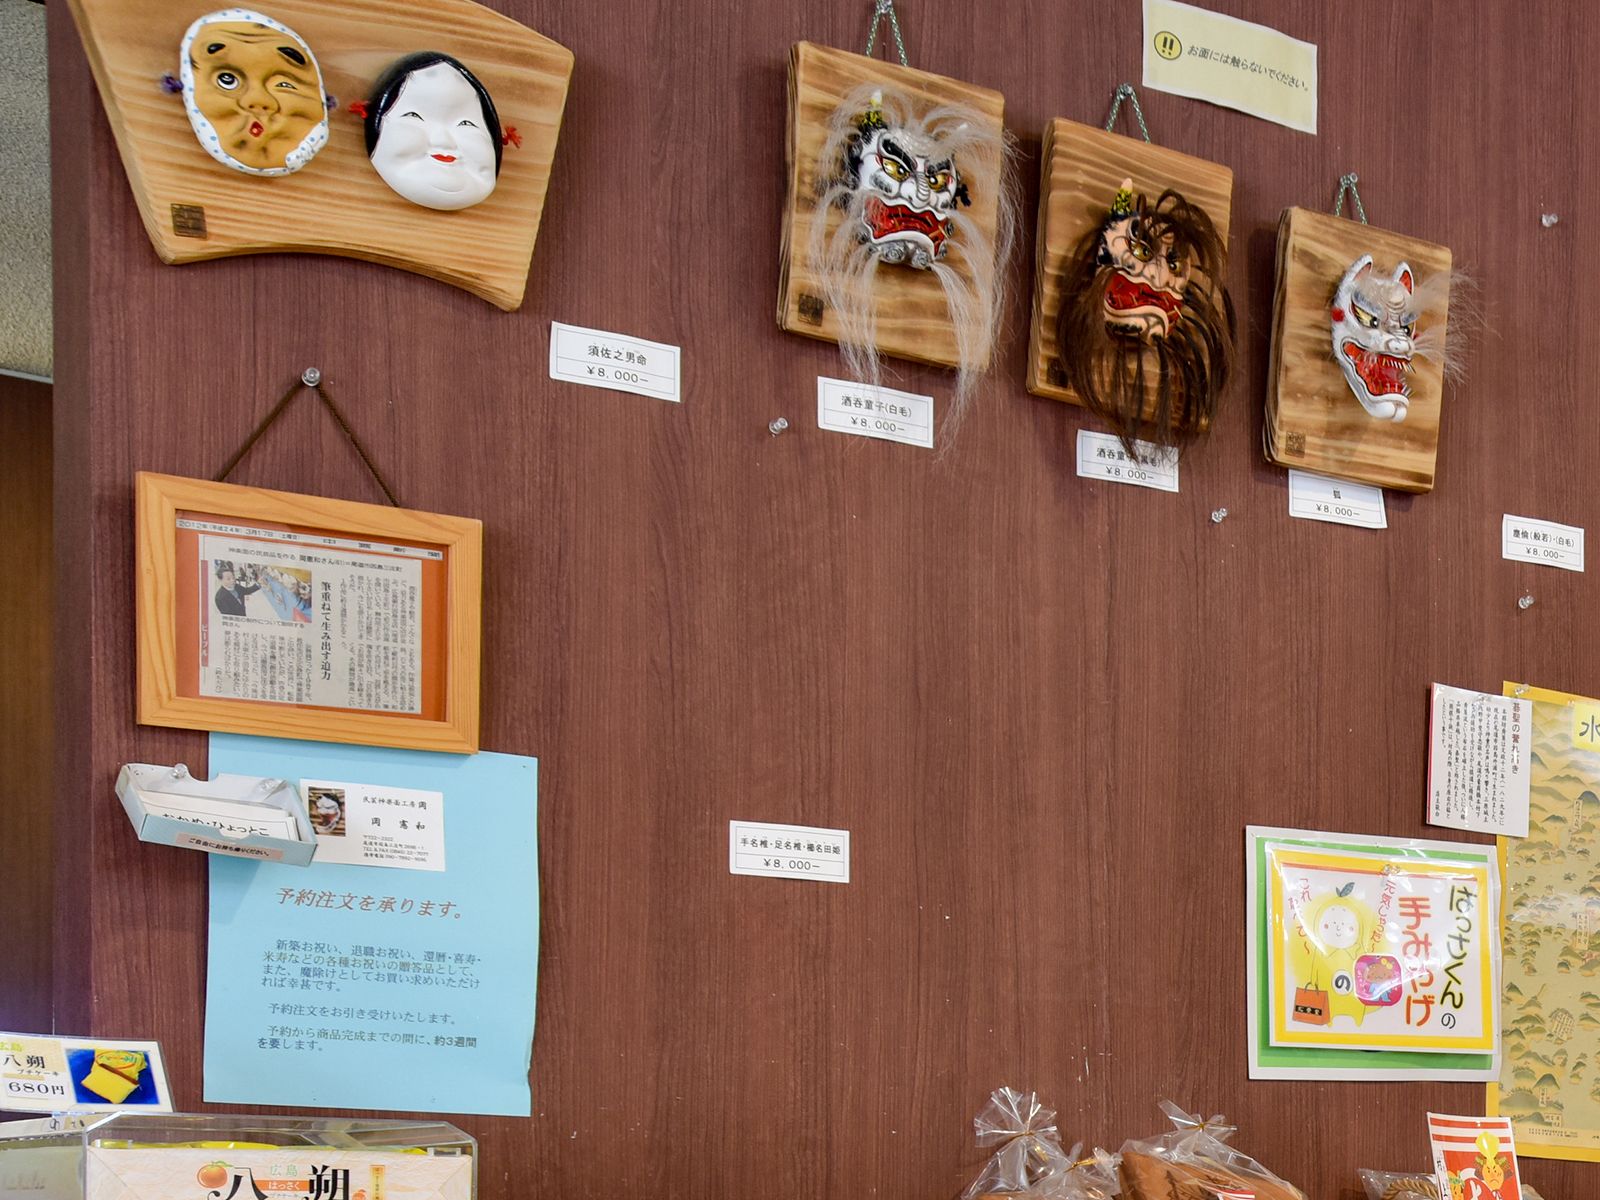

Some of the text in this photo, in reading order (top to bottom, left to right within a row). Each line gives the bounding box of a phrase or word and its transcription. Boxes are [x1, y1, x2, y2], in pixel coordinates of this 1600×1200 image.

[1187, 45, 1309, 91] お面には触らないでください。
[588, 344, 648, 366] 須佐之男命
[841, 394, 912, 418] 酒呑童子(白毛)
[320, 580, 332, 682] 筆重ねて生み出す迫力
[276, 887, 465, 920] 予約注文を承ります。
[263, 951, 477, 977] 米寿などの各種お祝いの贈答品として、
[261, 977, 342, 993] れば幸甚です。
[263, 964, 481, 990] また、魔除けとしてお買い求めいただけ
[268, 1003, 458, 1026] 予約注文をお引き受けいたします。
[257, 1036, 325, 1052] を要します。
[267, 1024, 478, 1049] 予約から商品完成までの間に、約3週間
[2, 1053, 46, 1069] 八朔
[8, 1081, 65, 1096] 680円
[268, 1180, 300, 1191] はっさく
